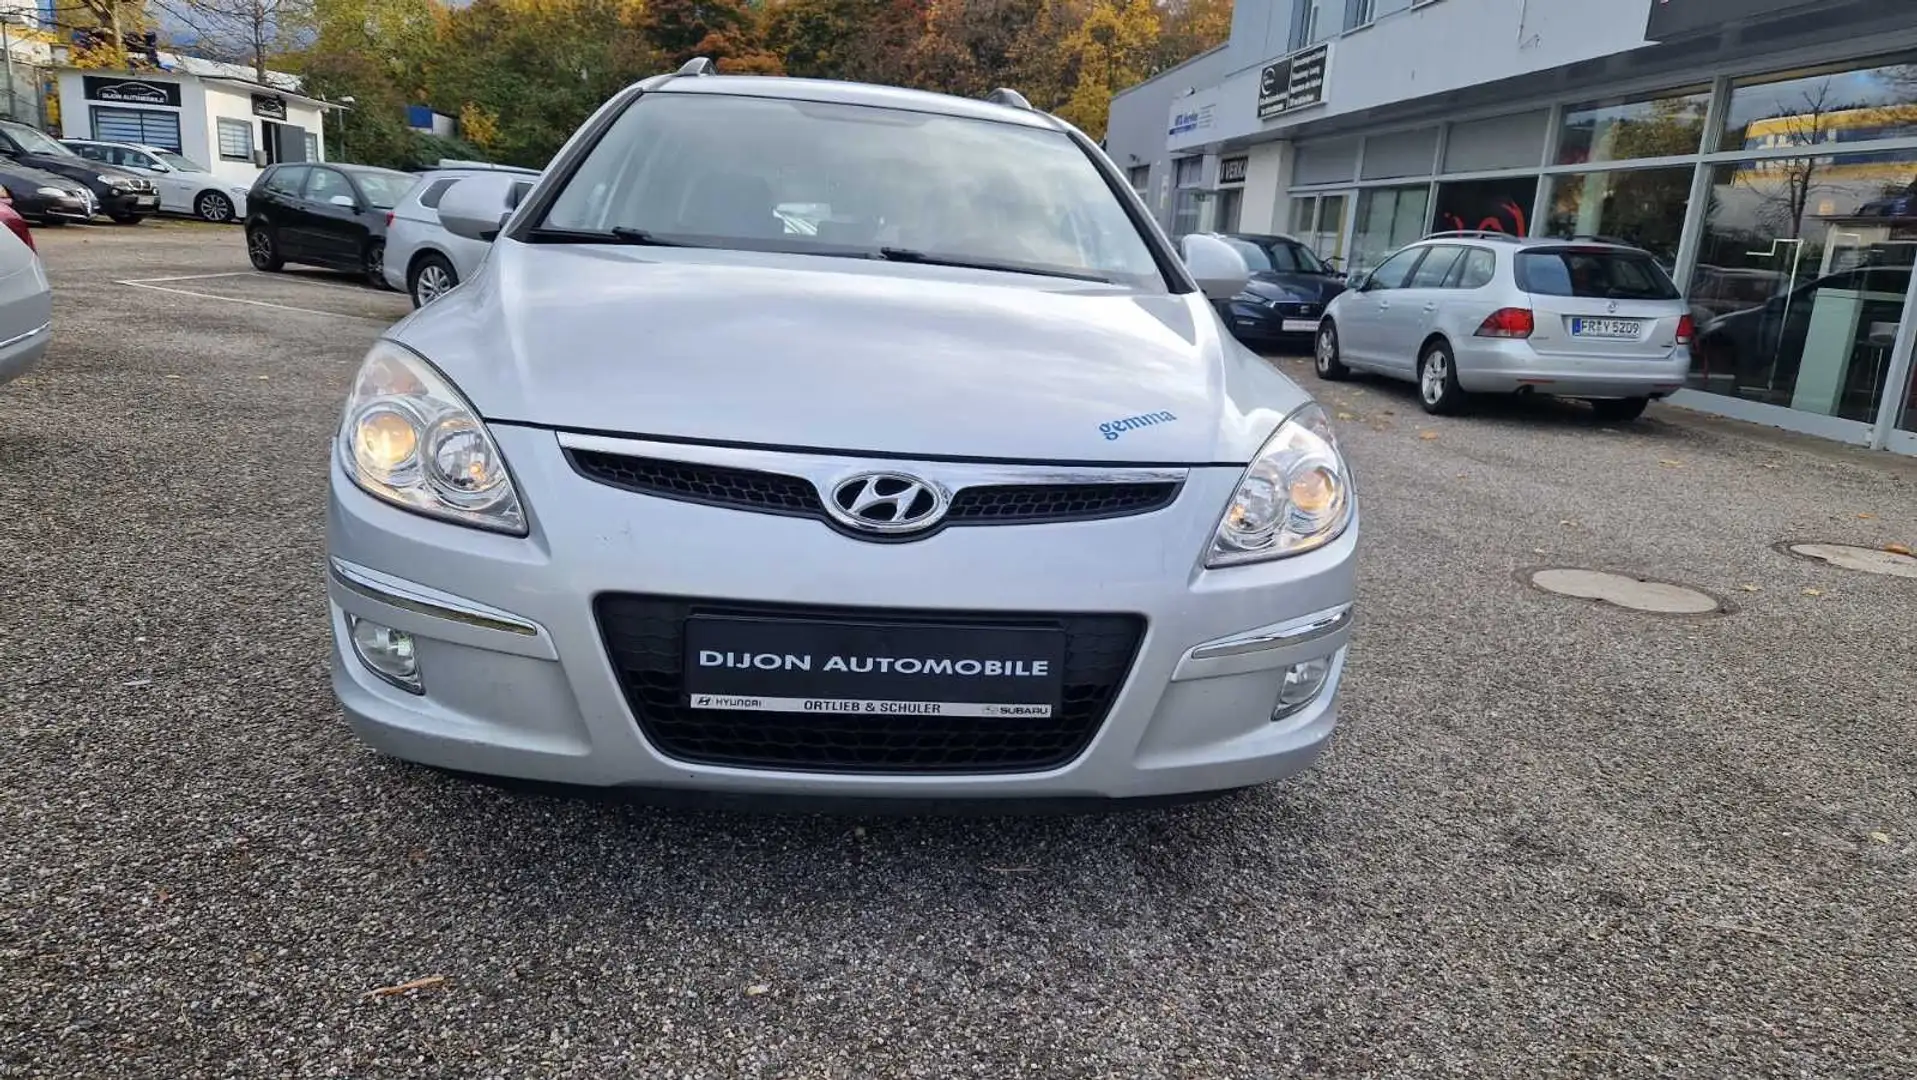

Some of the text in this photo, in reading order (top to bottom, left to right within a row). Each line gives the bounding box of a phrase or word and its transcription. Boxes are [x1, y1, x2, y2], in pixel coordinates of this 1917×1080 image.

[1581, 320, 1597, 332] FR
[1612, 321, 1639, 335] 5209
[1099, 411, 1177, 441] gemma
[699, 650, 1049, 677] DIJON AUTOMOBILE
[715, 699, 762, 708] HYUNDAI
[804, 700, 860, 712] ORTLIEB
[864, 702, 876, 712] &
[1000, 706, 1048, 715] SUBARU
